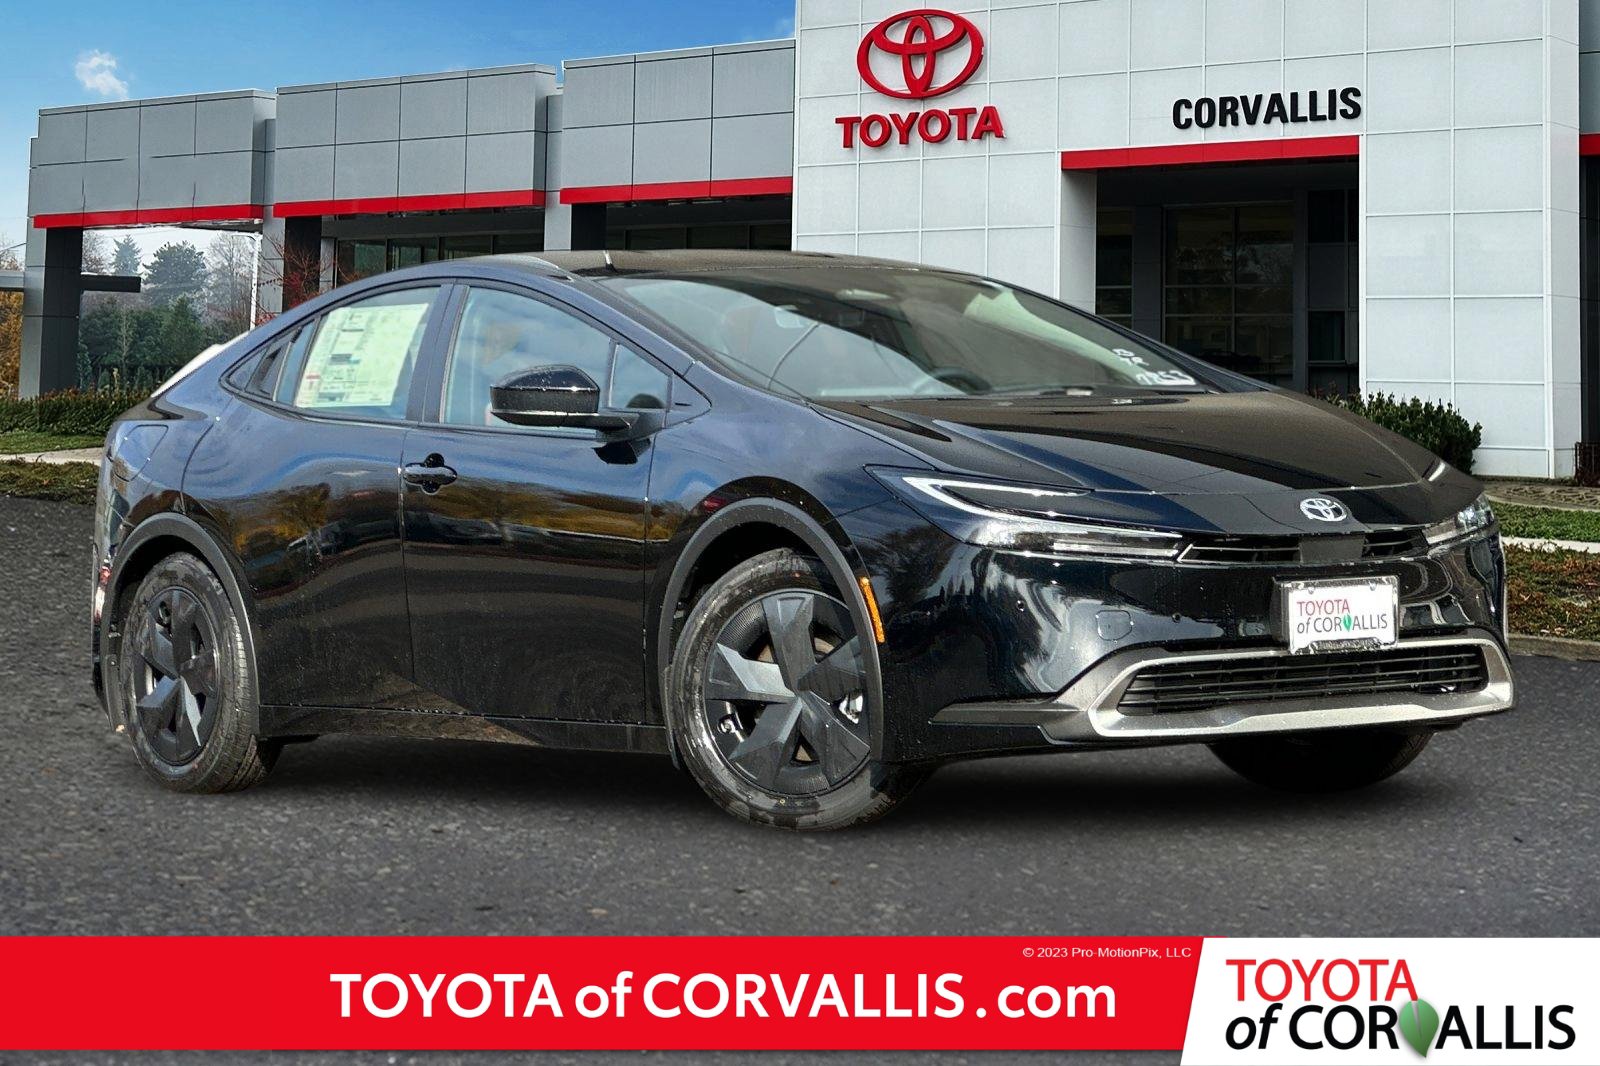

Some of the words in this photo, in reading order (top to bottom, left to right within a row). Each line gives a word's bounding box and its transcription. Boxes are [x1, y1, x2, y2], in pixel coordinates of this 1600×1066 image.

[1172, 86, 1362, 130] CORVALLIS
[835, 105, 1005, 149] TOYOTA
[1297, 599, 1351, 616] TOYOTA
[1297, 616, 1311, 634] of
